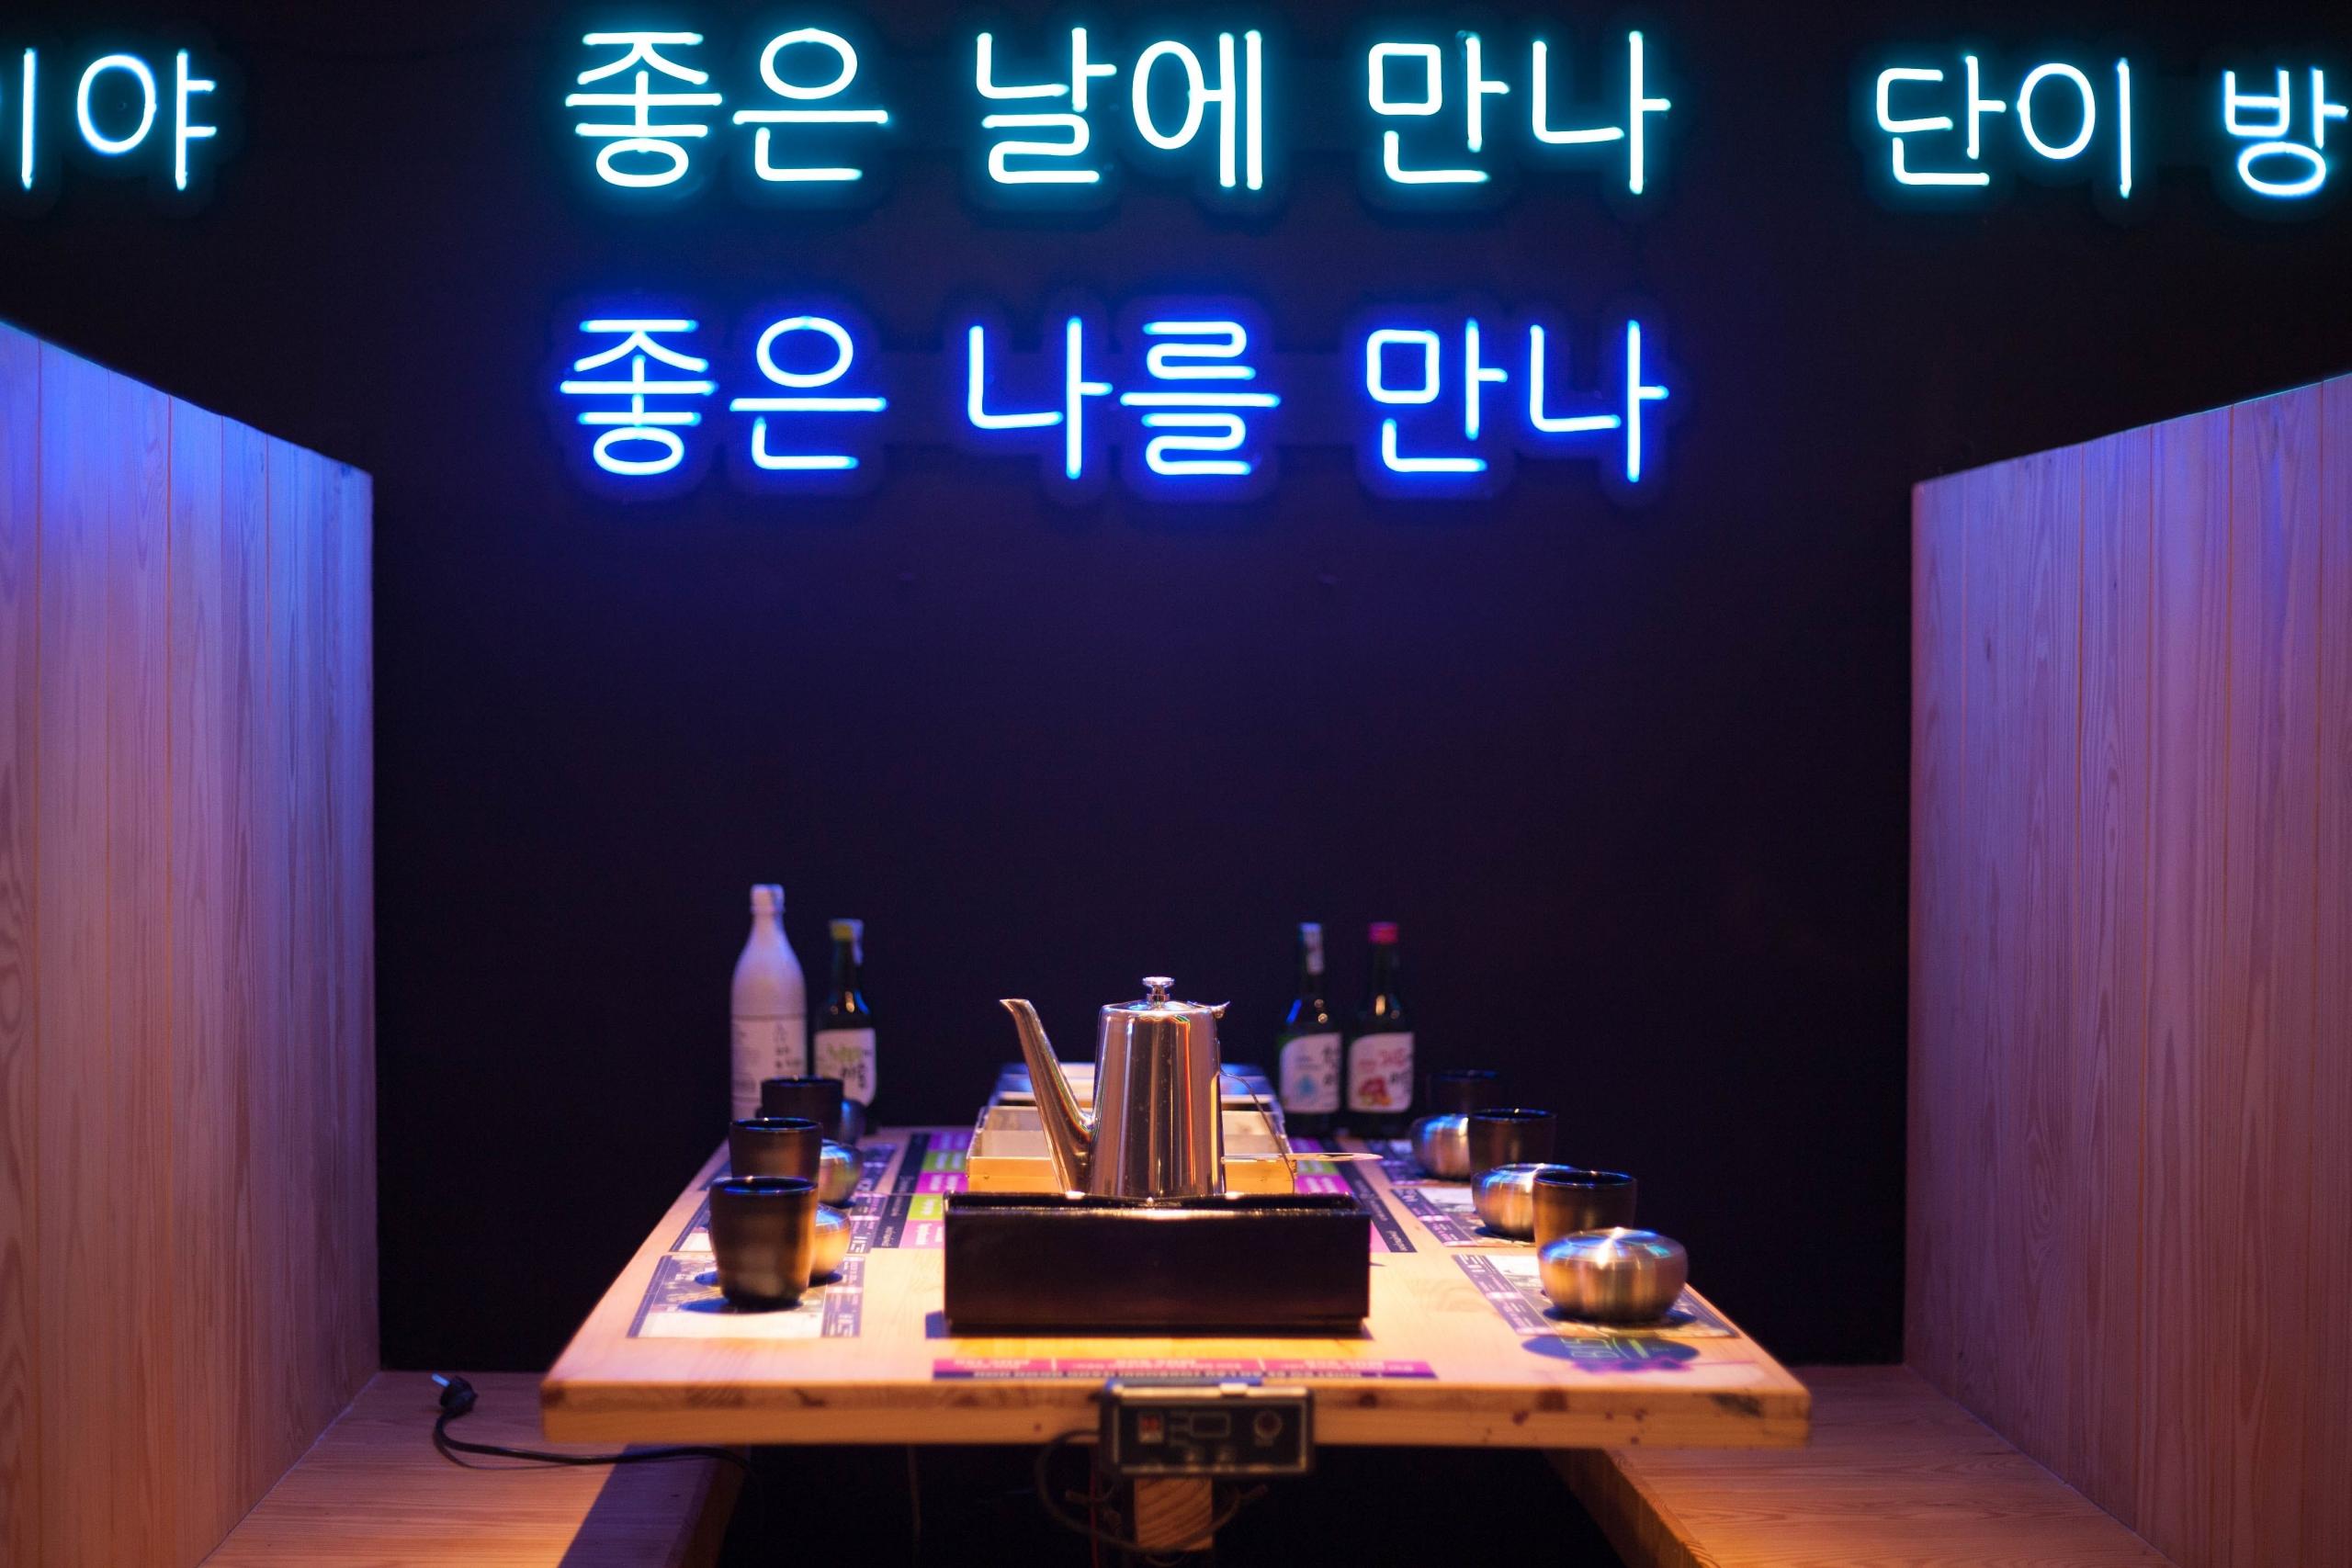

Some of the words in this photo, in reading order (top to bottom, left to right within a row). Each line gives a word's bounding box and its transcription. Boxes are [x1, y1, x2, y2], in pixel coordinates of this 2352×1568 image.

[564, 27, 893, 189] 좋은
[976, 27, 1263, 190] 날에
[1368, 30, 1671, 195] 만나
[1876, 53, 2132, 198] 단이
[2222, 67, 2349, 198] 방
[560, 316, 887, 475] 좋은
[967, 317, 1280, 479] 나를
[1366, 320, 1668, 482] 만나
